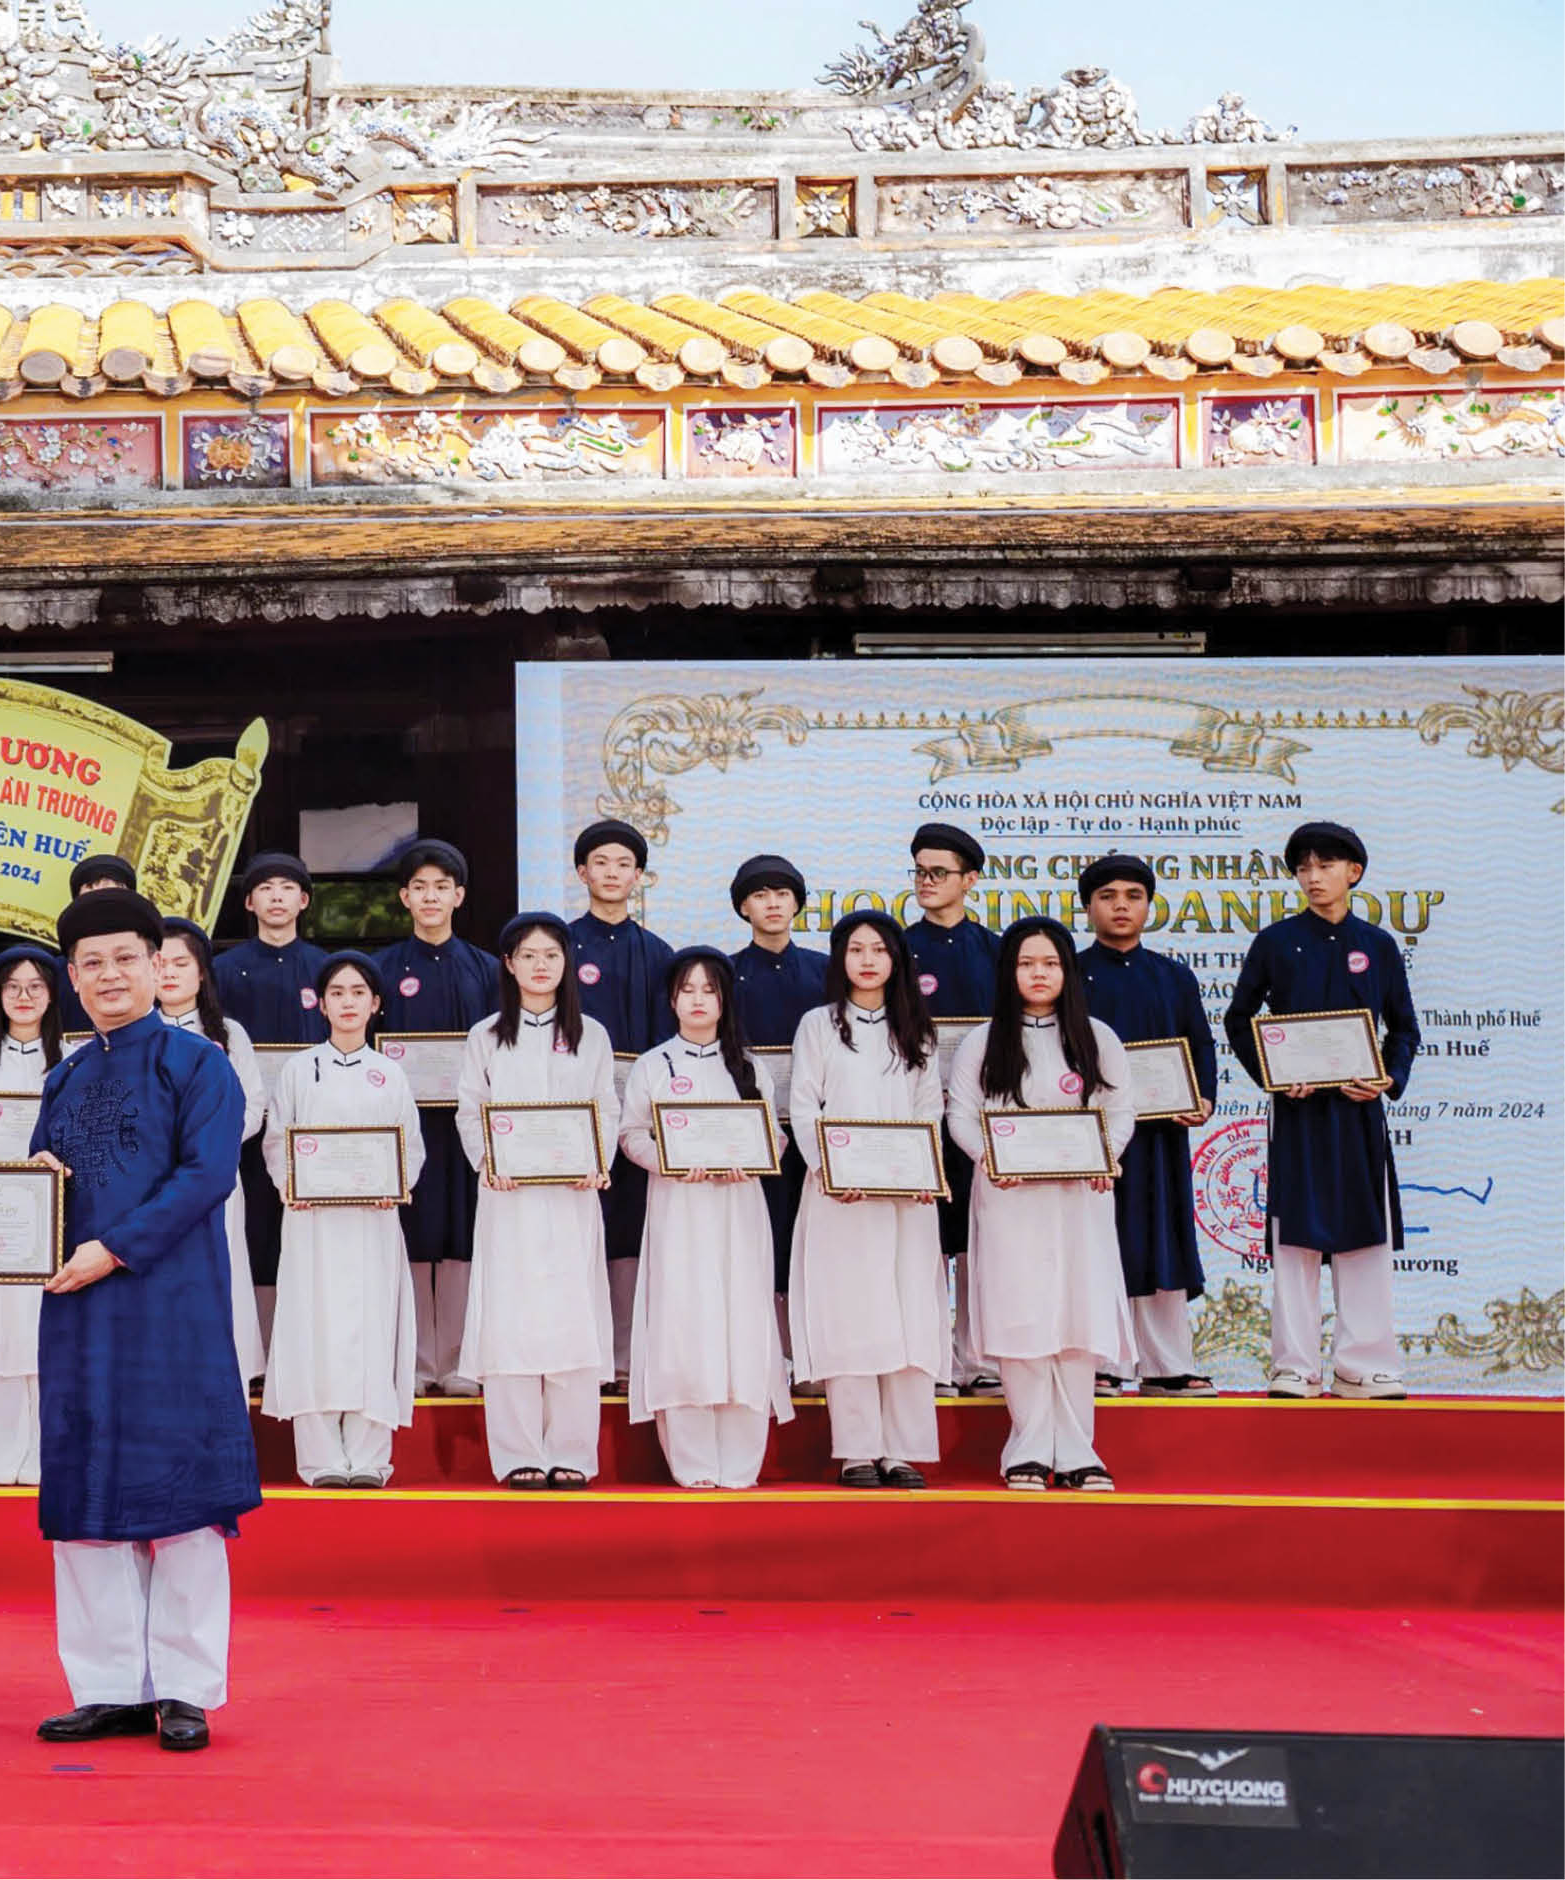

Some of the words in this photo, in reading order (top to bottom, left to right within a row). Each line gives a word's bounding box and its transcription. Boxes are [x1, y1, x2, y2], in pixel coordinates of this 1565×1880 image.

[37, 784, 118, 836] TRƯỜNG
[918, 791, 971, 811] CỘNG
[977, 792, 1019, 809] HÒA
[1023, 792, 1048, 809] XÃ
[1054, 791, 1089, 811] HỘI
[1094, 789, 1134, 809] CHỦ
[1140, 791, 1202, 809] NGHĨA
[1207, 791, 1253, 812] VIỆT
[1258, 794, 1302, 809] NAM
[981, 816, 1016, 833] Độc
[1021, 816, 1050, 834] lập
[1067, 816, 1093, 834] Tự
[1098, 816, 1123, 831] do
[1139, 816, 1189, 834] Hạnh
[1195, 816, 1241, 834] phúc
[33, 833, 92, 864] HUẾ
[0, 862, 42, 885] 2024
[1422, 1009, 1472, 1026] Thành
[1476, 1008, 1507, 1030] phố
[1510, 1009, 1542, 1027] Huế
[1446, 1038, 1491, 1056] Huế
[1385, 1101, 1431, 1121] háng
[1437, 1101, 1449, 1117] 7
[1453, 1102, 1493, 1118] năm
[1498, 1101, 1546, 1118] 2024
[1167, 1777, 1286, 1798] HUYCUONG
